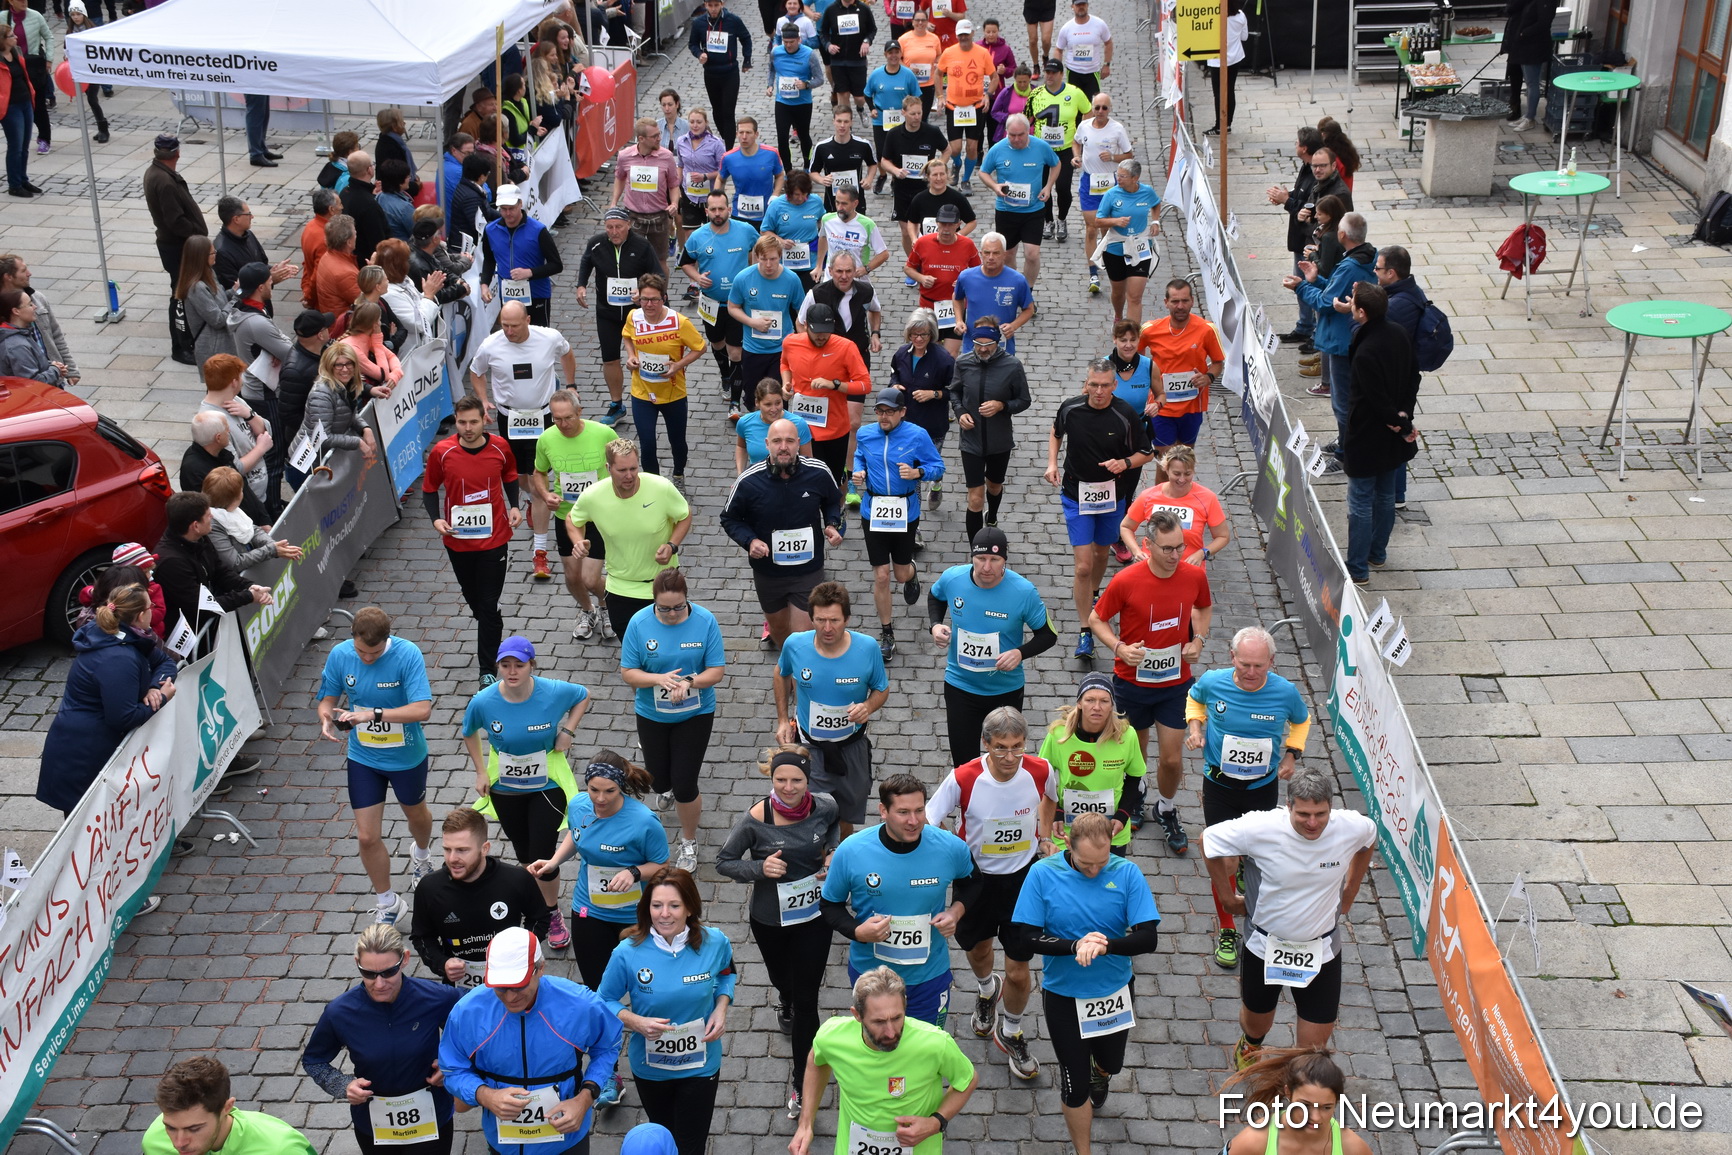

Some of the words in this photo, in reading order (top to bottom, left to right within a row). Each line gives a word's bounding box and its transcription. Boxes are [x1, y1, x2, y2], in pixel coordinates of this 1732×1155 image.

[1179, 5, 1221, 19] Jugend
[841, 20, 857, 28] 2658
[1191, 19, 1213, 32] lauf
[85, 44, 133, 62] BMW
[138, 48, 278, 72] ConnectedDrive
[1075, 49, 1090, 57] 2267
[88, 63, 143, 79] Vernetzt,
[147, 69, 165, 79] um
[167, 68, 187, 80] frei
[190, 71, 204, 81] zu
[206, 72, 236, 83] sein.
[781, 82, 795, 91] 2654
[889, 115, 900, 123] 148
[958, 111, 971, 119] 241
[1044, 132, 1062, 140] 2665
[906, 161, 923, 170] 2262
[637, 174, 652, 182] 292
[835, 178, 854, 186] 2261
[1007, 190, 1026, 199] 2546
[741, 202, 760, 211] 2114
[786, 251, 806, 260] 2302
[505, 287, 525, 297] 2021
[611, 286, 632, 296] 2591
[636, 337, 653, 345] MAX
[656, 332, 681, 343] BÖGL
[642, 361, 664, 371] 2623
[1168, 380, 1194, 391] 2574
[798, 403, 823, 414] 2418
[513, 417, 539, 427] 2048
[297, 447, 311, 467] swn
[1084, 490, 1110, 502] 2390
[876, 507, 902, 518] 2219
[457, 515, 487, 527] 2410
[778, 540, 807, 552] 2187
[246, 562, 297, 658] BOCK
[985, 611, 1009, 619] BOCK
[175, 628, 190, 651] swn
[963, 642, 992, 657] 2374
[1391, 637, 1407, 659] swn
[1144, 656, 1175, 670] 2060
[816, 715, 849, 729] 2935
[1250, 713, 1275, 721] BOCK
[366, 721, 391, 733] 250
[528, 723, 552, 731] BOCK
[1229, 749, 1263, 764] 2354
[505, 764, 540, 777] 2547
[1014, 808, 1031, 816] MID
[1071, 801, 1107, 814] 2905
[994, 829, 1022, 843] 259
[600, 844, 625, 852] BOCK
[910, 878, 938, 886] BOCK
[787, 886, 822, 909] 2736
[884, 930, 923, 945] 2756
[1273, 950, 1314, 968] 2562
[683, 971, 712, 983] BOCK
[1282, 970, 1303, 978] Roland
[1085, 996, 1124, 1018] 2324
[1097, 1017, 1118, 1027] Norbert
[35, 993, 88, 1078] Service-Line:
[88, 980, 95, 993] 0
[1488, 1023, 1496, 1038] die
[654, 1036, 697, 1054] 2908
[386, 1109, 420, 1127] 188
[393, 1129, 417, 1137] Martina
